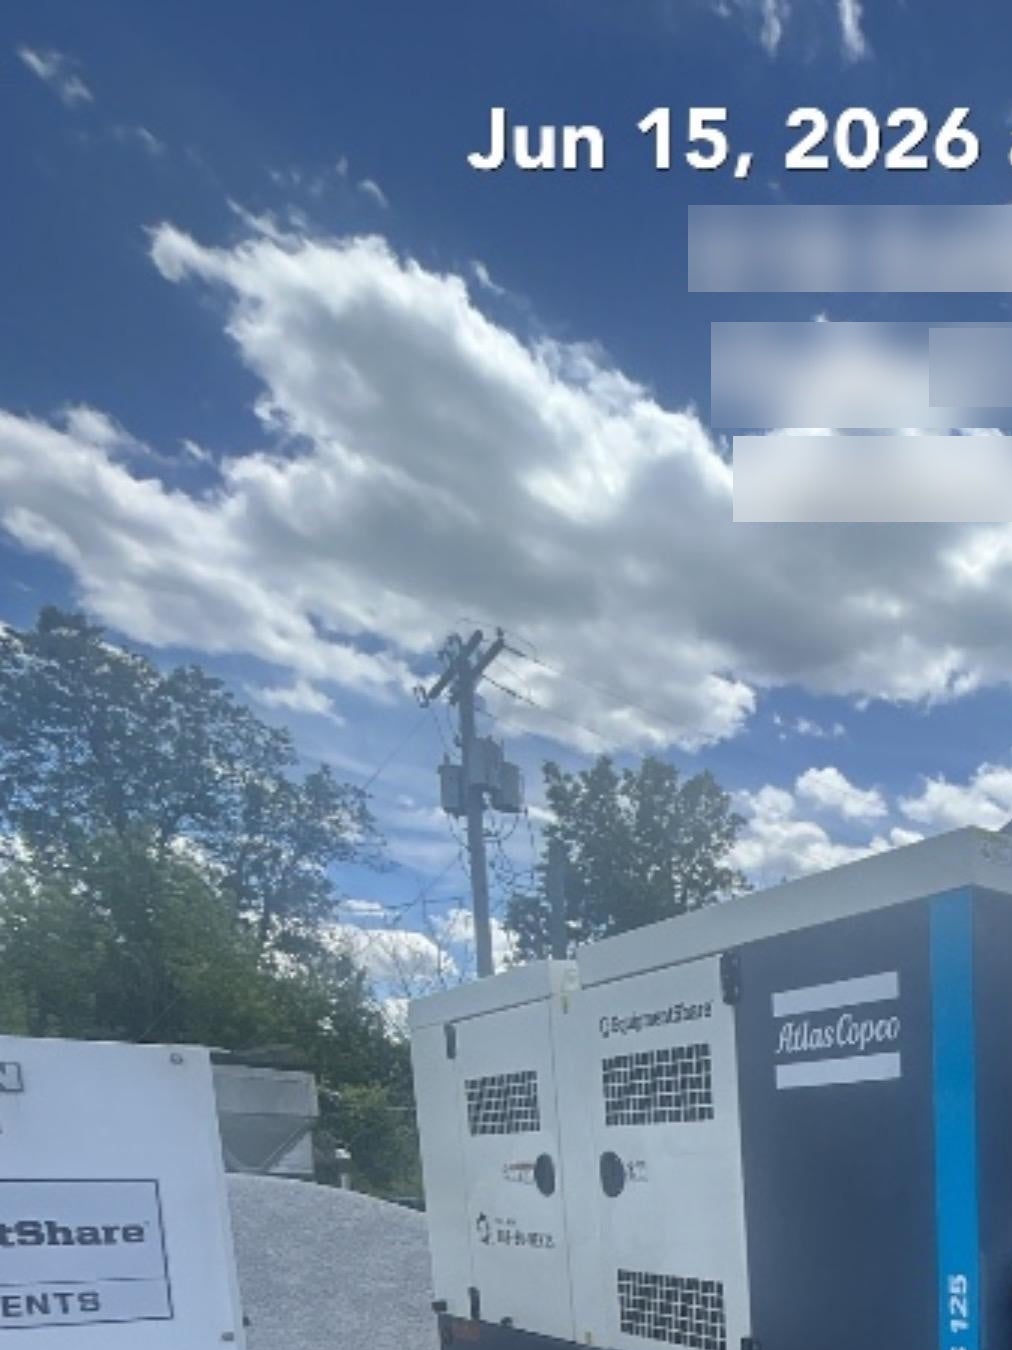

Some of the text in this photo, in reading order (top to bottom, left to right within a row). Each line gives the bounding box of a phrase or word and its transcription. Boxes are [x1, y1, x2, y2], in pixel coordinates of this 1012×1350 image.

[775, 1013, 900, 1054] Atlas Copco
[948, 1273, 970, 1334] 125
